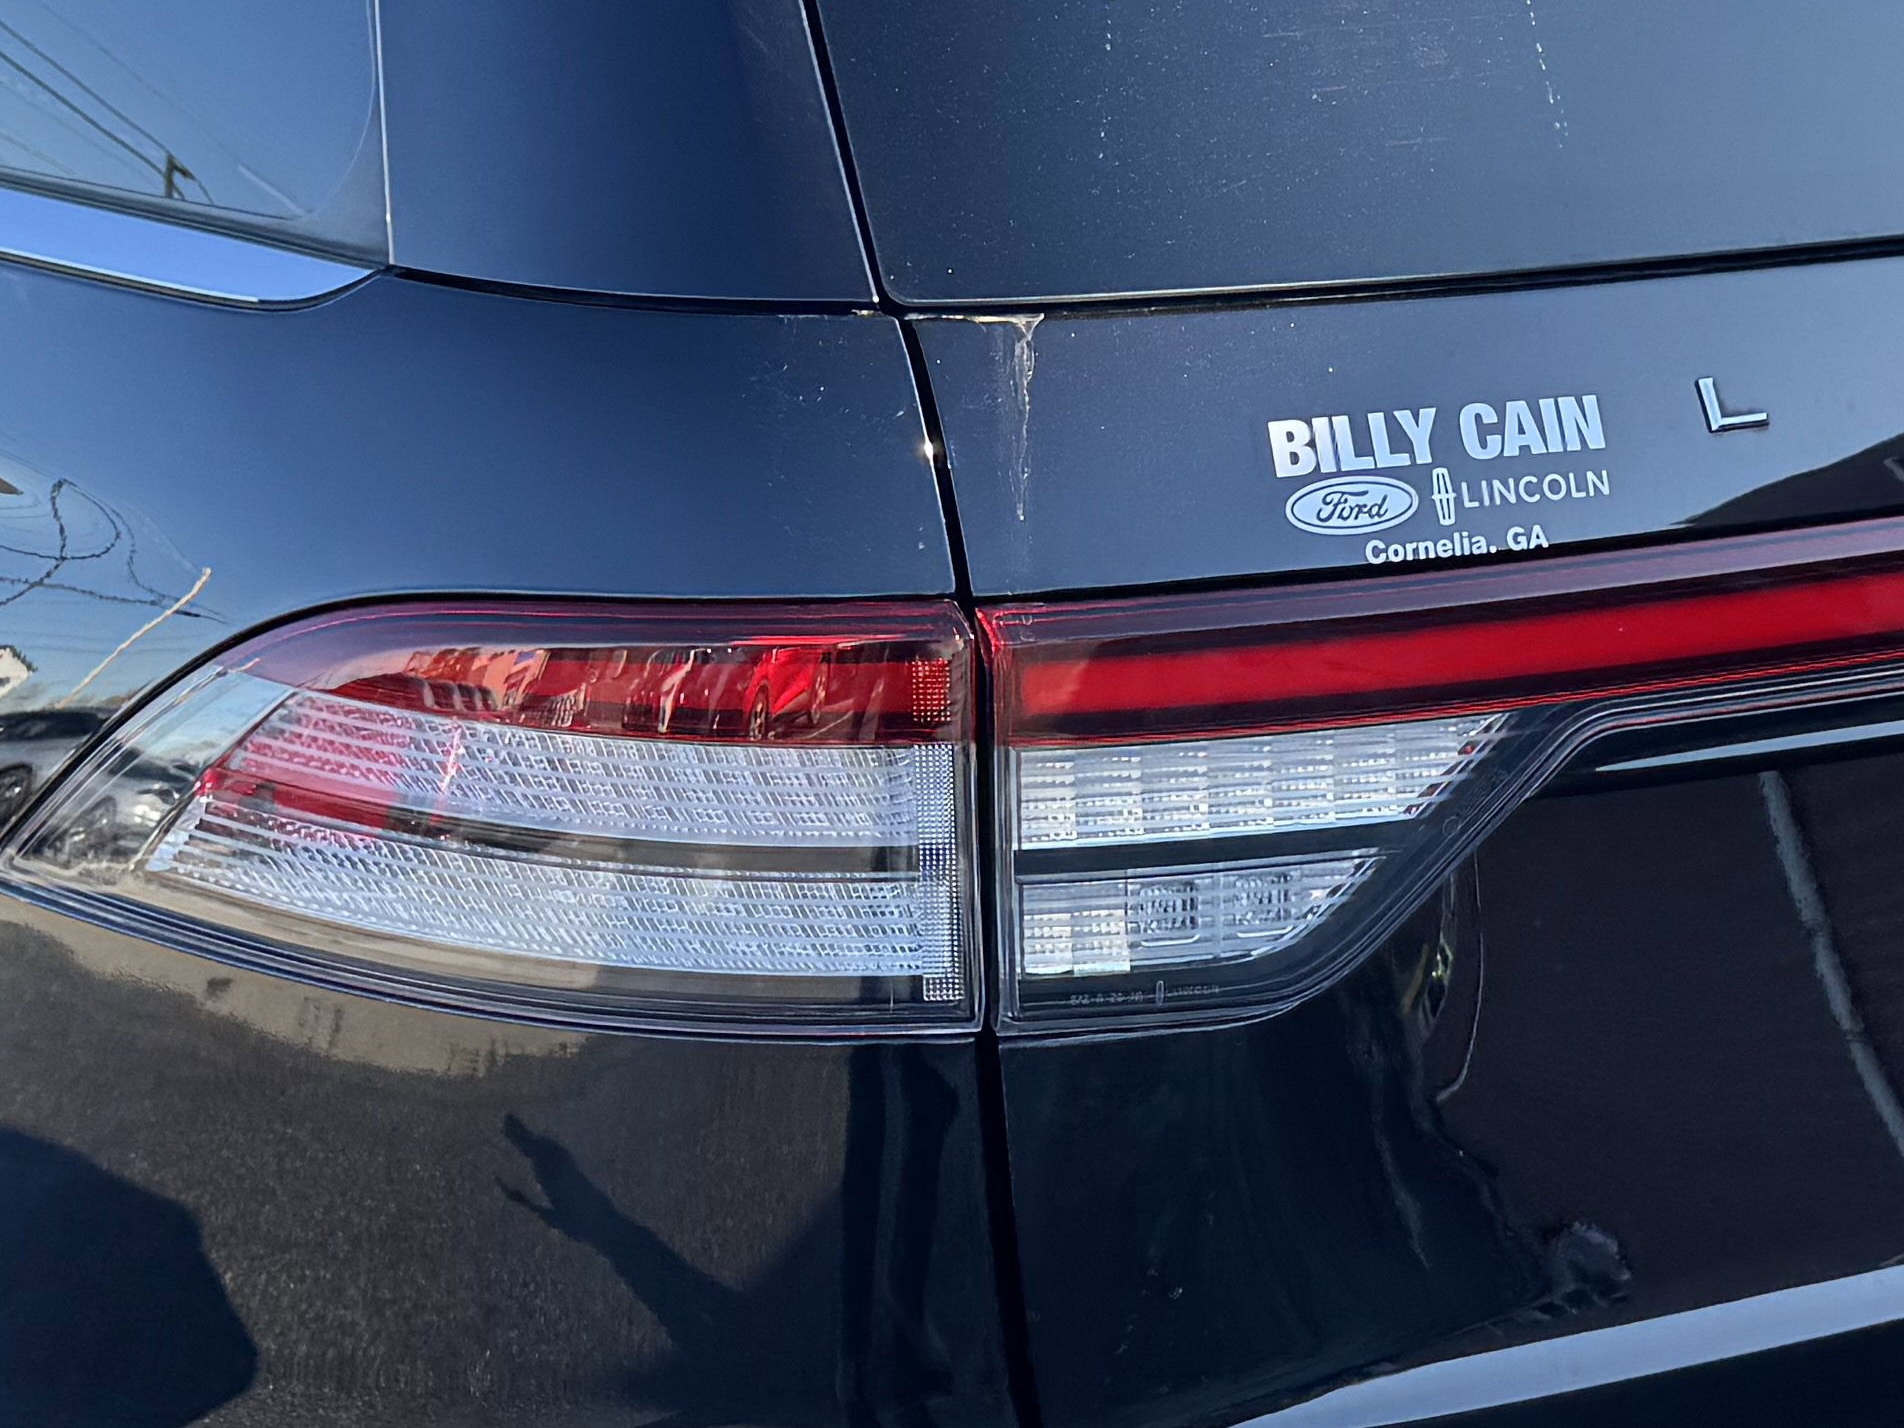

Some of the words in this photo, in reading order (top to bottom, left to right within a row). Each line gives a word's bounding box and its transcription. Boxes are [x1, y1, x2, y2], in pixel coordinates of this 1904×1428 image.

[1267, 407, 1436, 478] BILLY
[1459, 395, 1606, 460] CAIN
[1461, 469, 1610, 508] LINCOLN
[1506, 525, 1549, 551] GA
